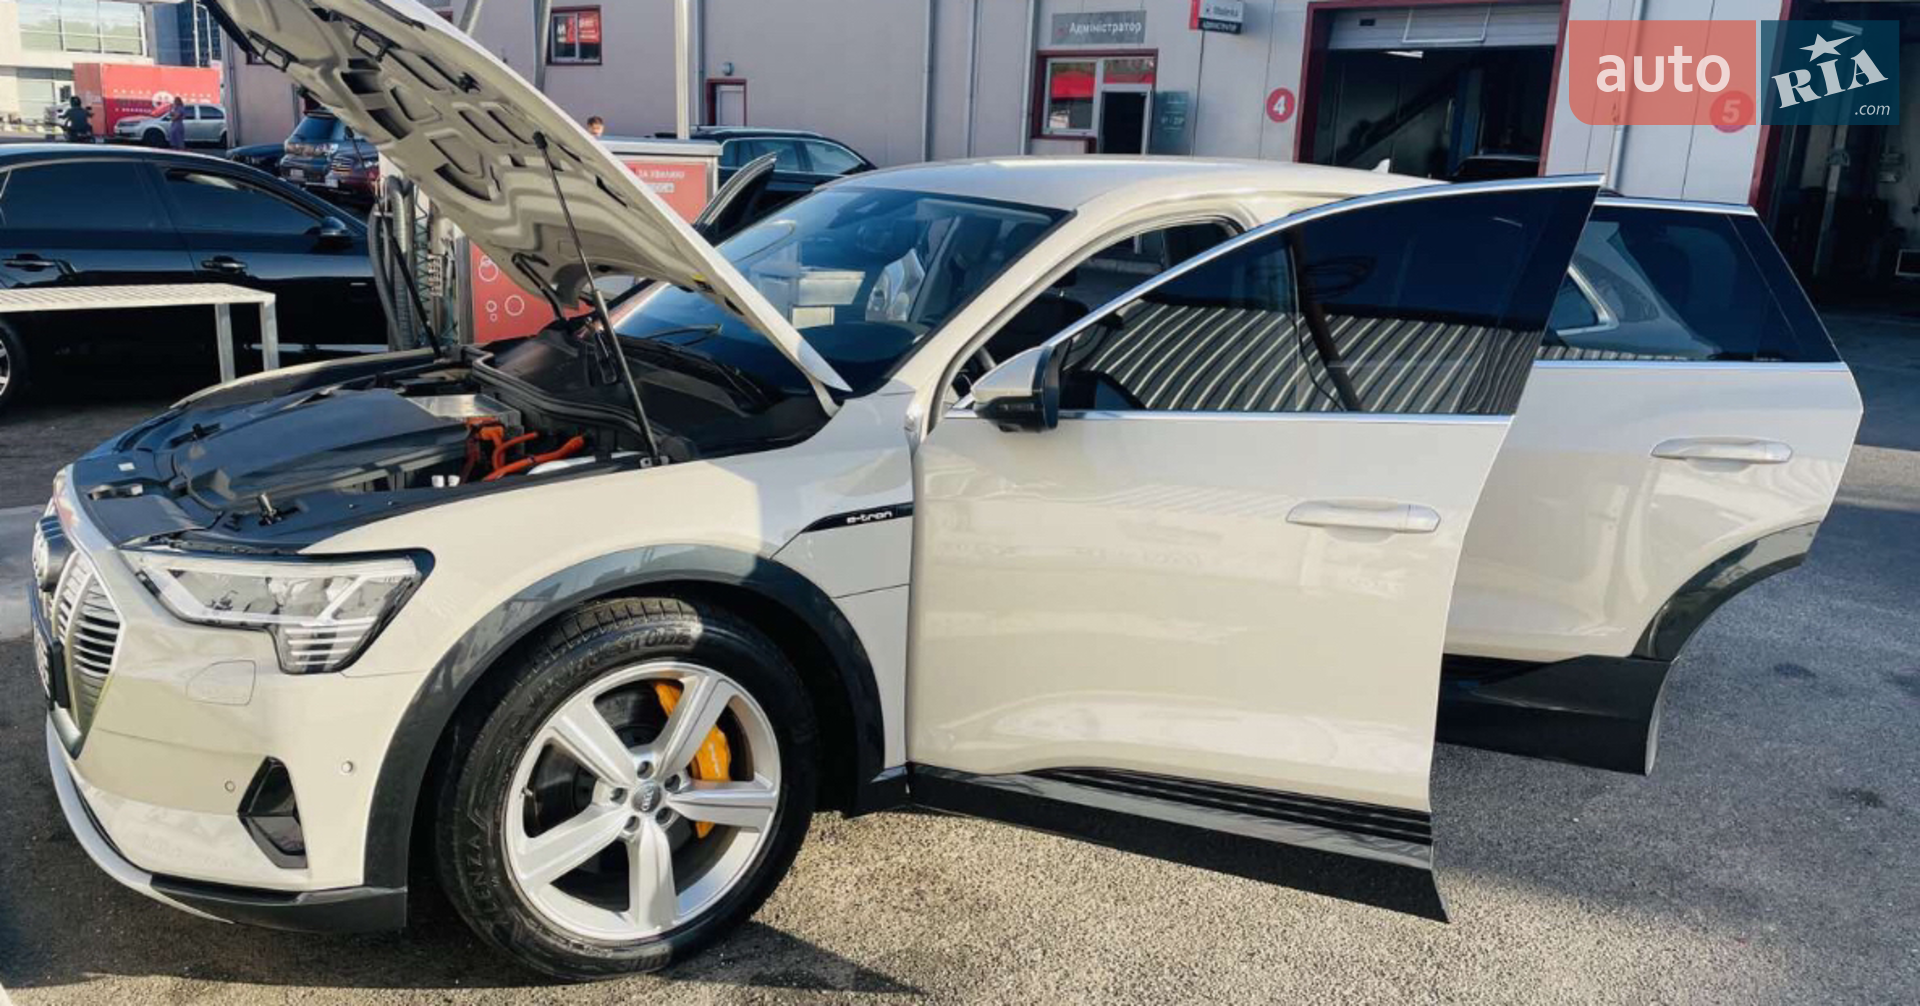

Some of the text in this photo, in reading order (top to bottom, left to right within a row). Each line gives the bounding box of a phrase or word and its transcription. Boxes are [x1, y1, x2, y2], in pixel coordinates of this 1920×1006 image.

[1069, 22, 1142, 35] Адміністратор
[1272, 95, 1286, 115] 4
[1721, 98, 1741, 124] 5
[846, 510, 893, 524] e-tron
